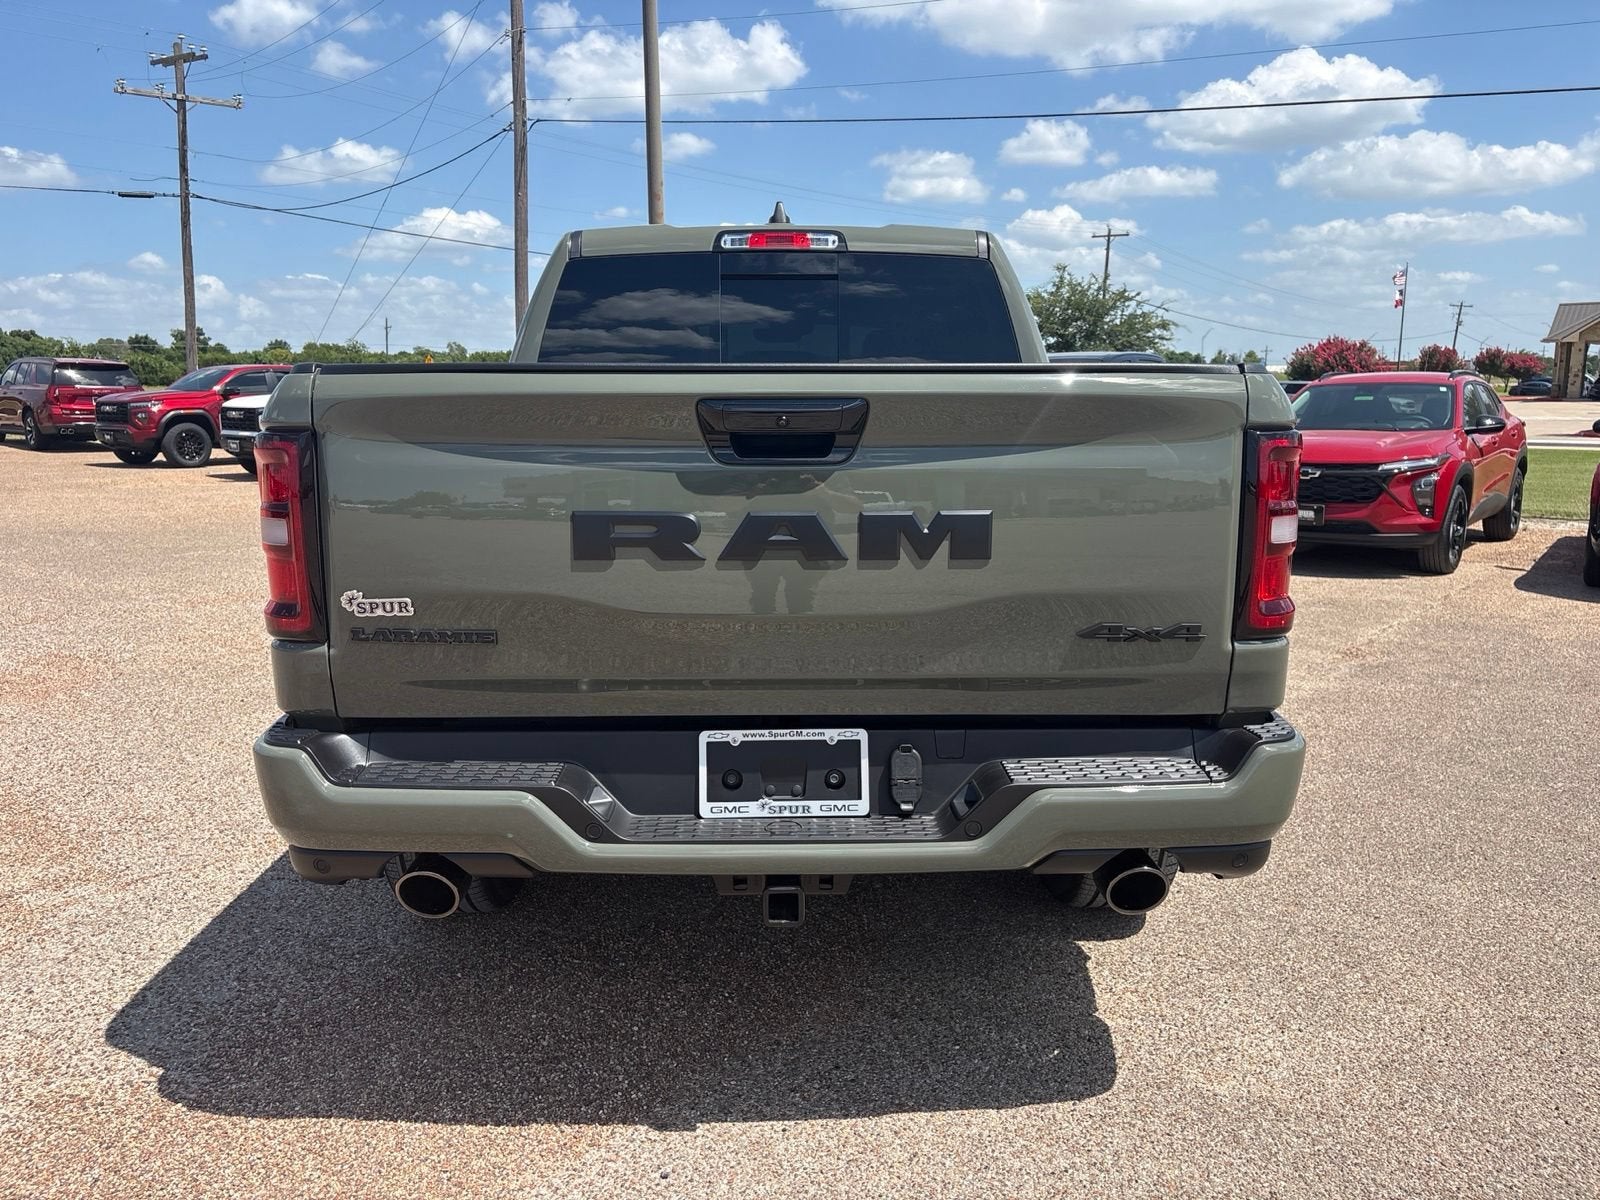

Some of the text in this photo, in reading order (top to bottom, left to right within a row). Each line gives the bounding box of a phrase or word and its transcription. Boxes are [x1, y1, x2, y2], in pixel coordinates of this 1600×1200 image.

[572, 510, 993, 560] RAM
[356, 600, 412, 615] SPUR
[351, 627, 497, 645] LARAMIE
[741, 730, 826, 739] www.SpurGM.com
[710, 804, 859, 815] GMC SPUR GMC
